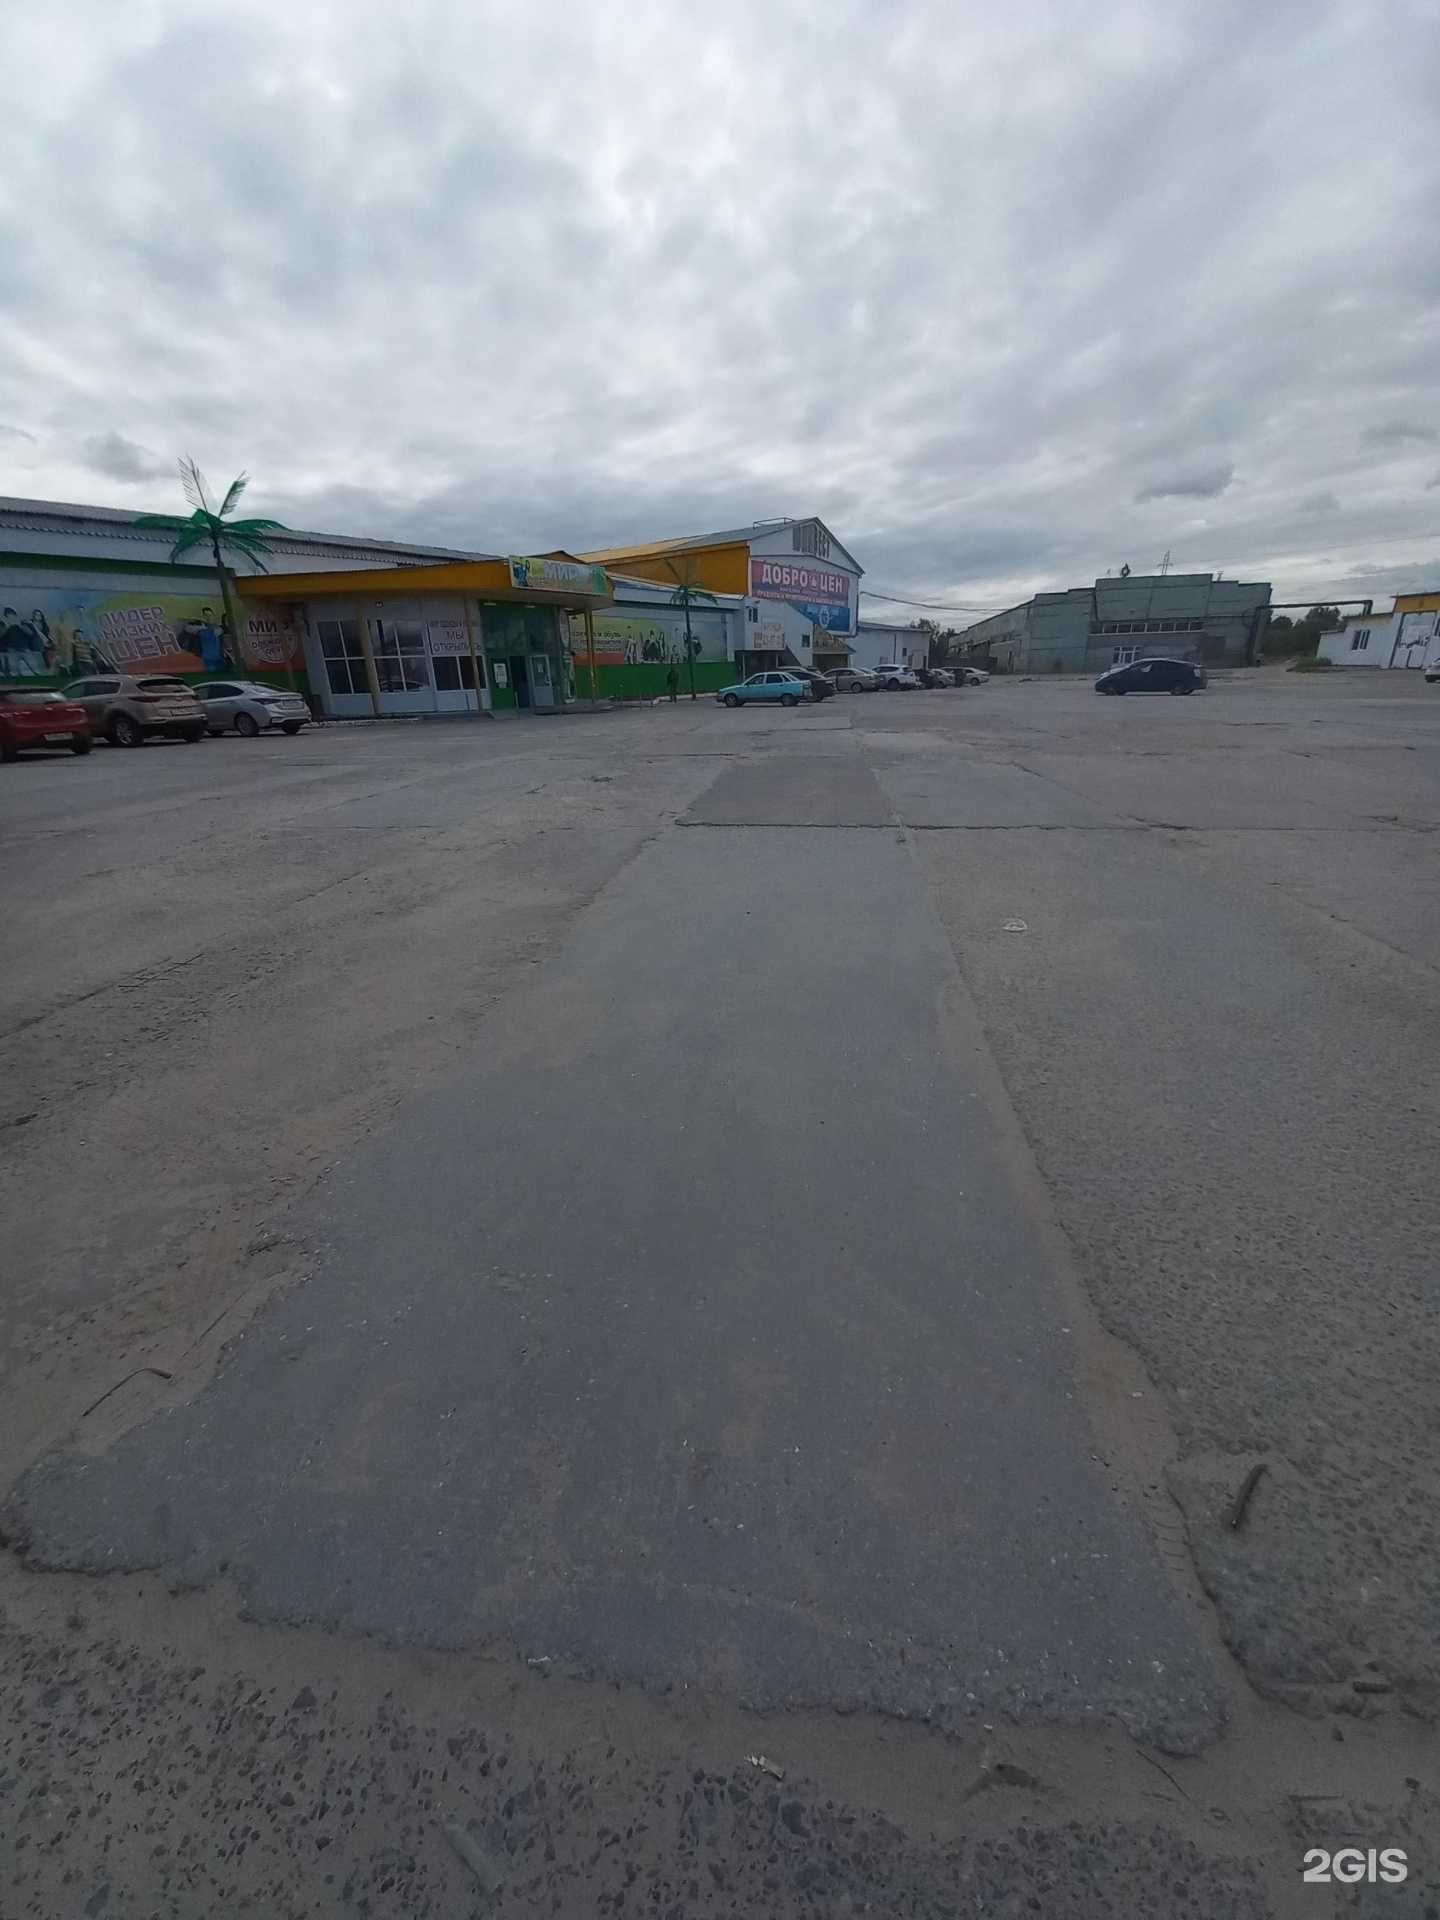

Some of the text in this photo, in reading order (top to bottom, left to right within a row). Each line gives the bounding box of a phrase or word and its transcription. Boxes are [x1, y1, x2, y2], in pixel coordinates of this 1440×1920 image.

[762, 564, 808, 588] ДОБРО
[820, 573, 843, 593] ЦЕН
[98, 607, 164, 625] ЛИДЕР
[102, 622, 172, 640] НИЗКИХ
[446, 631, 465, 641] МЫ
[108, 632, 181, 661] ЦЕН
[433, 641, 482, 652] ОТКРЫЛСЬ
